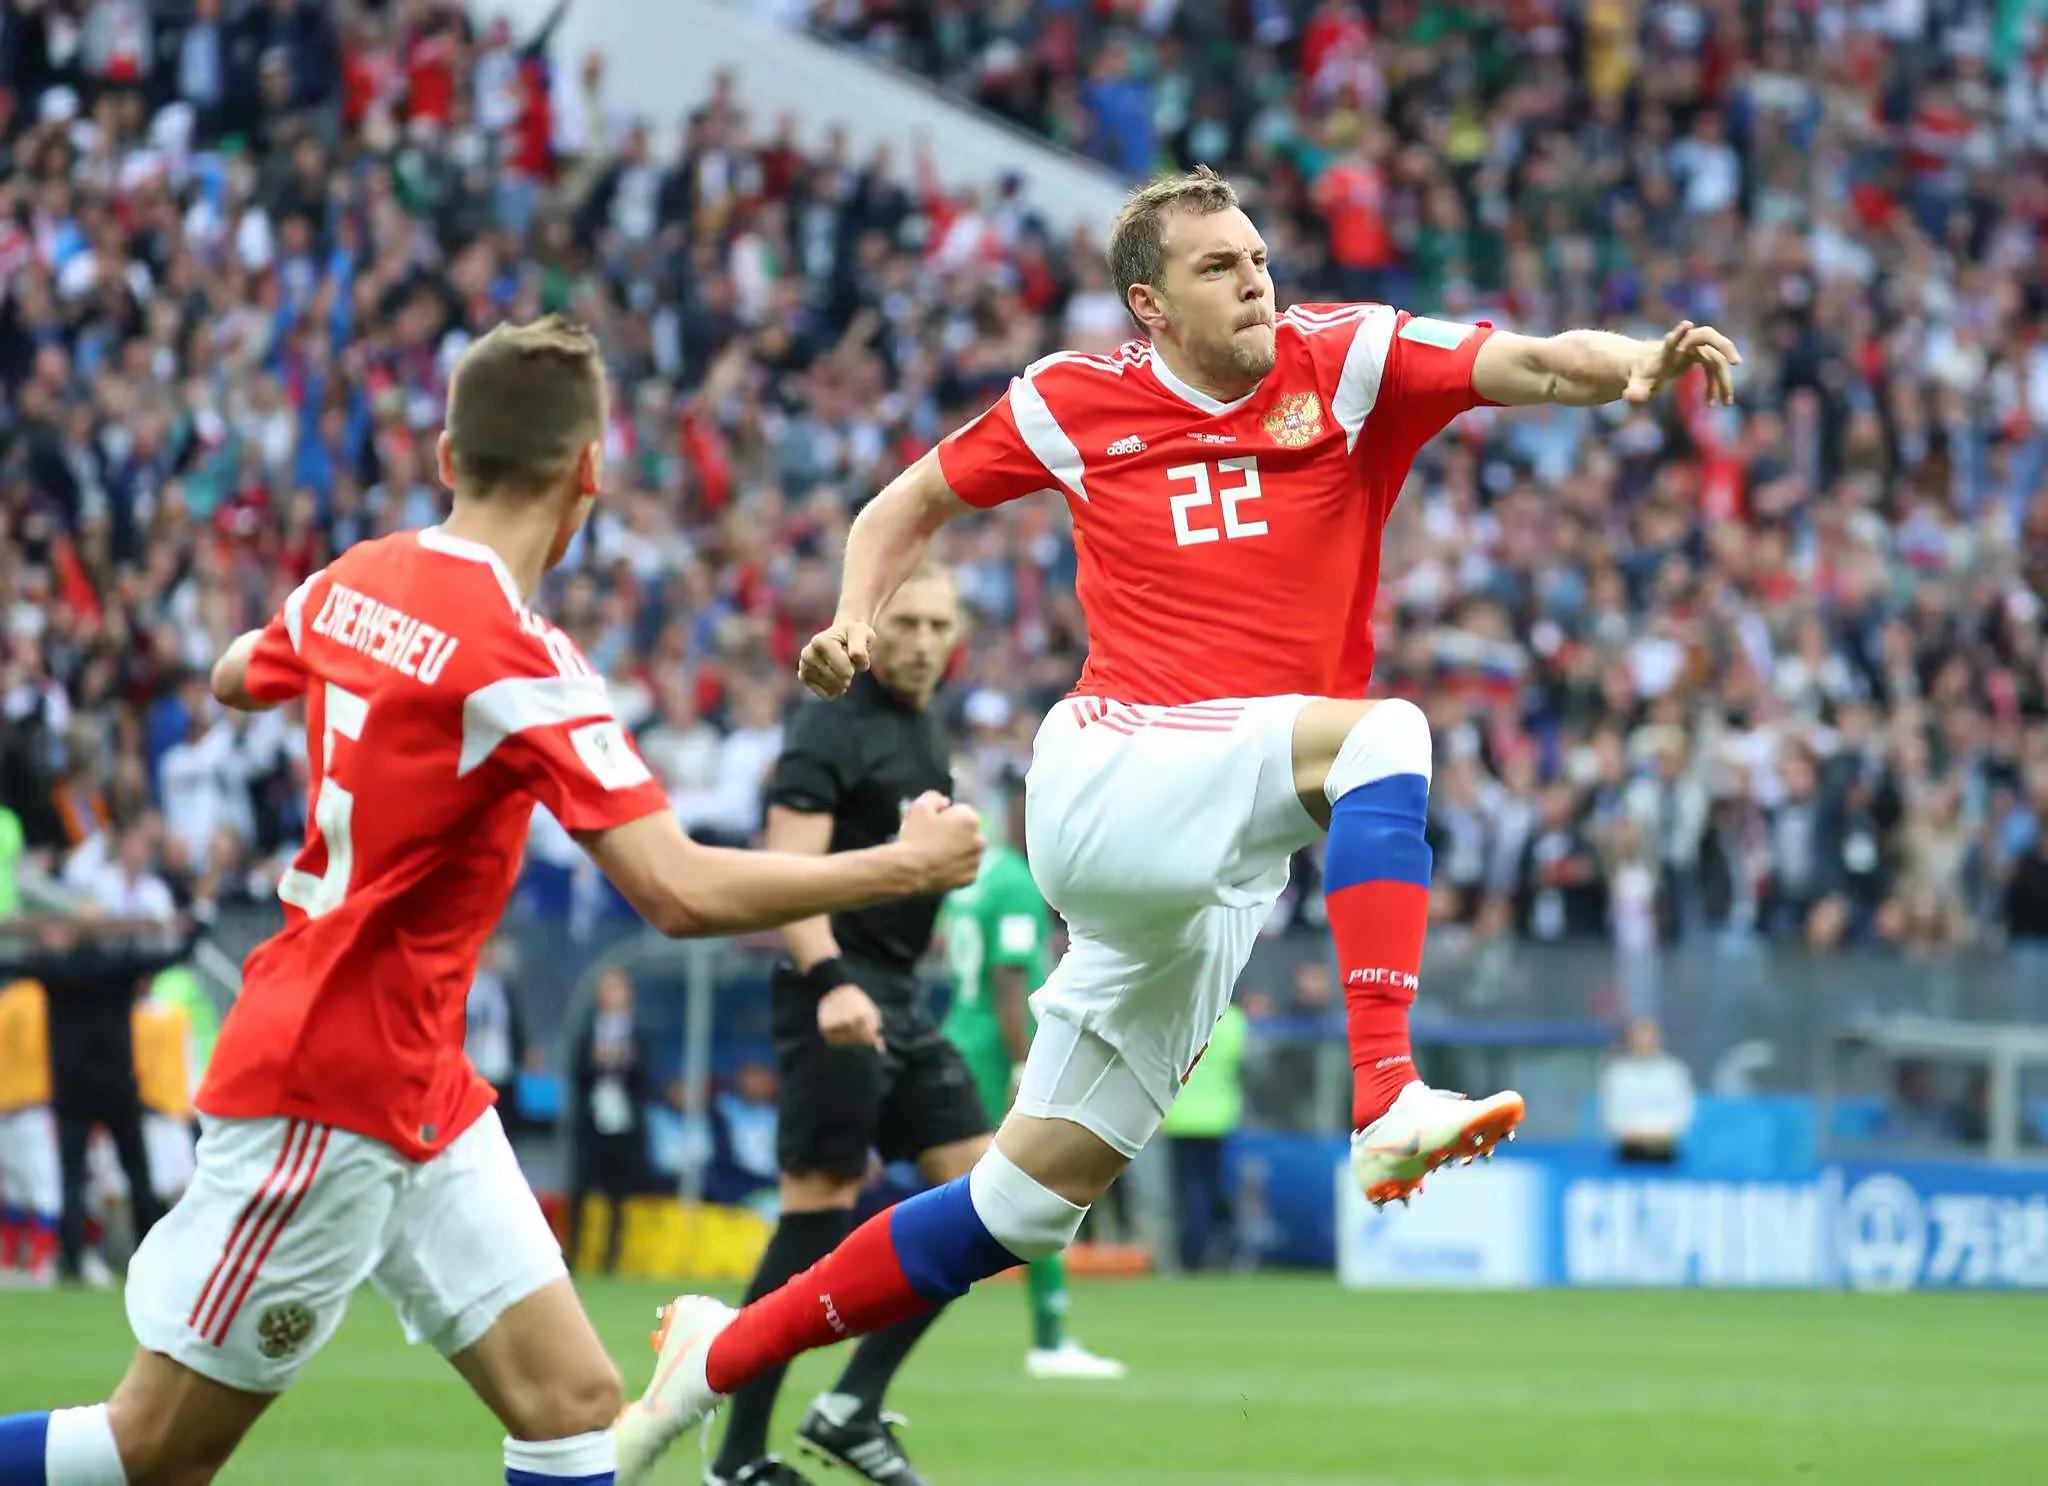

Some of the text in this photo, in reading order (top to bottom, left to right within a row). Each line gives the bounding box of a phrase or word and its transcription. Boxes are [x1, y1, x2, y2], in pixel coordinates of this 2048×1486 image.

[1106, 442, 1148, 456] adidas
[1166, 455, 1269, 547] 22
[311, 582, 459, 687] CHERYSHEV
[277, 682, 370, 921] 5
